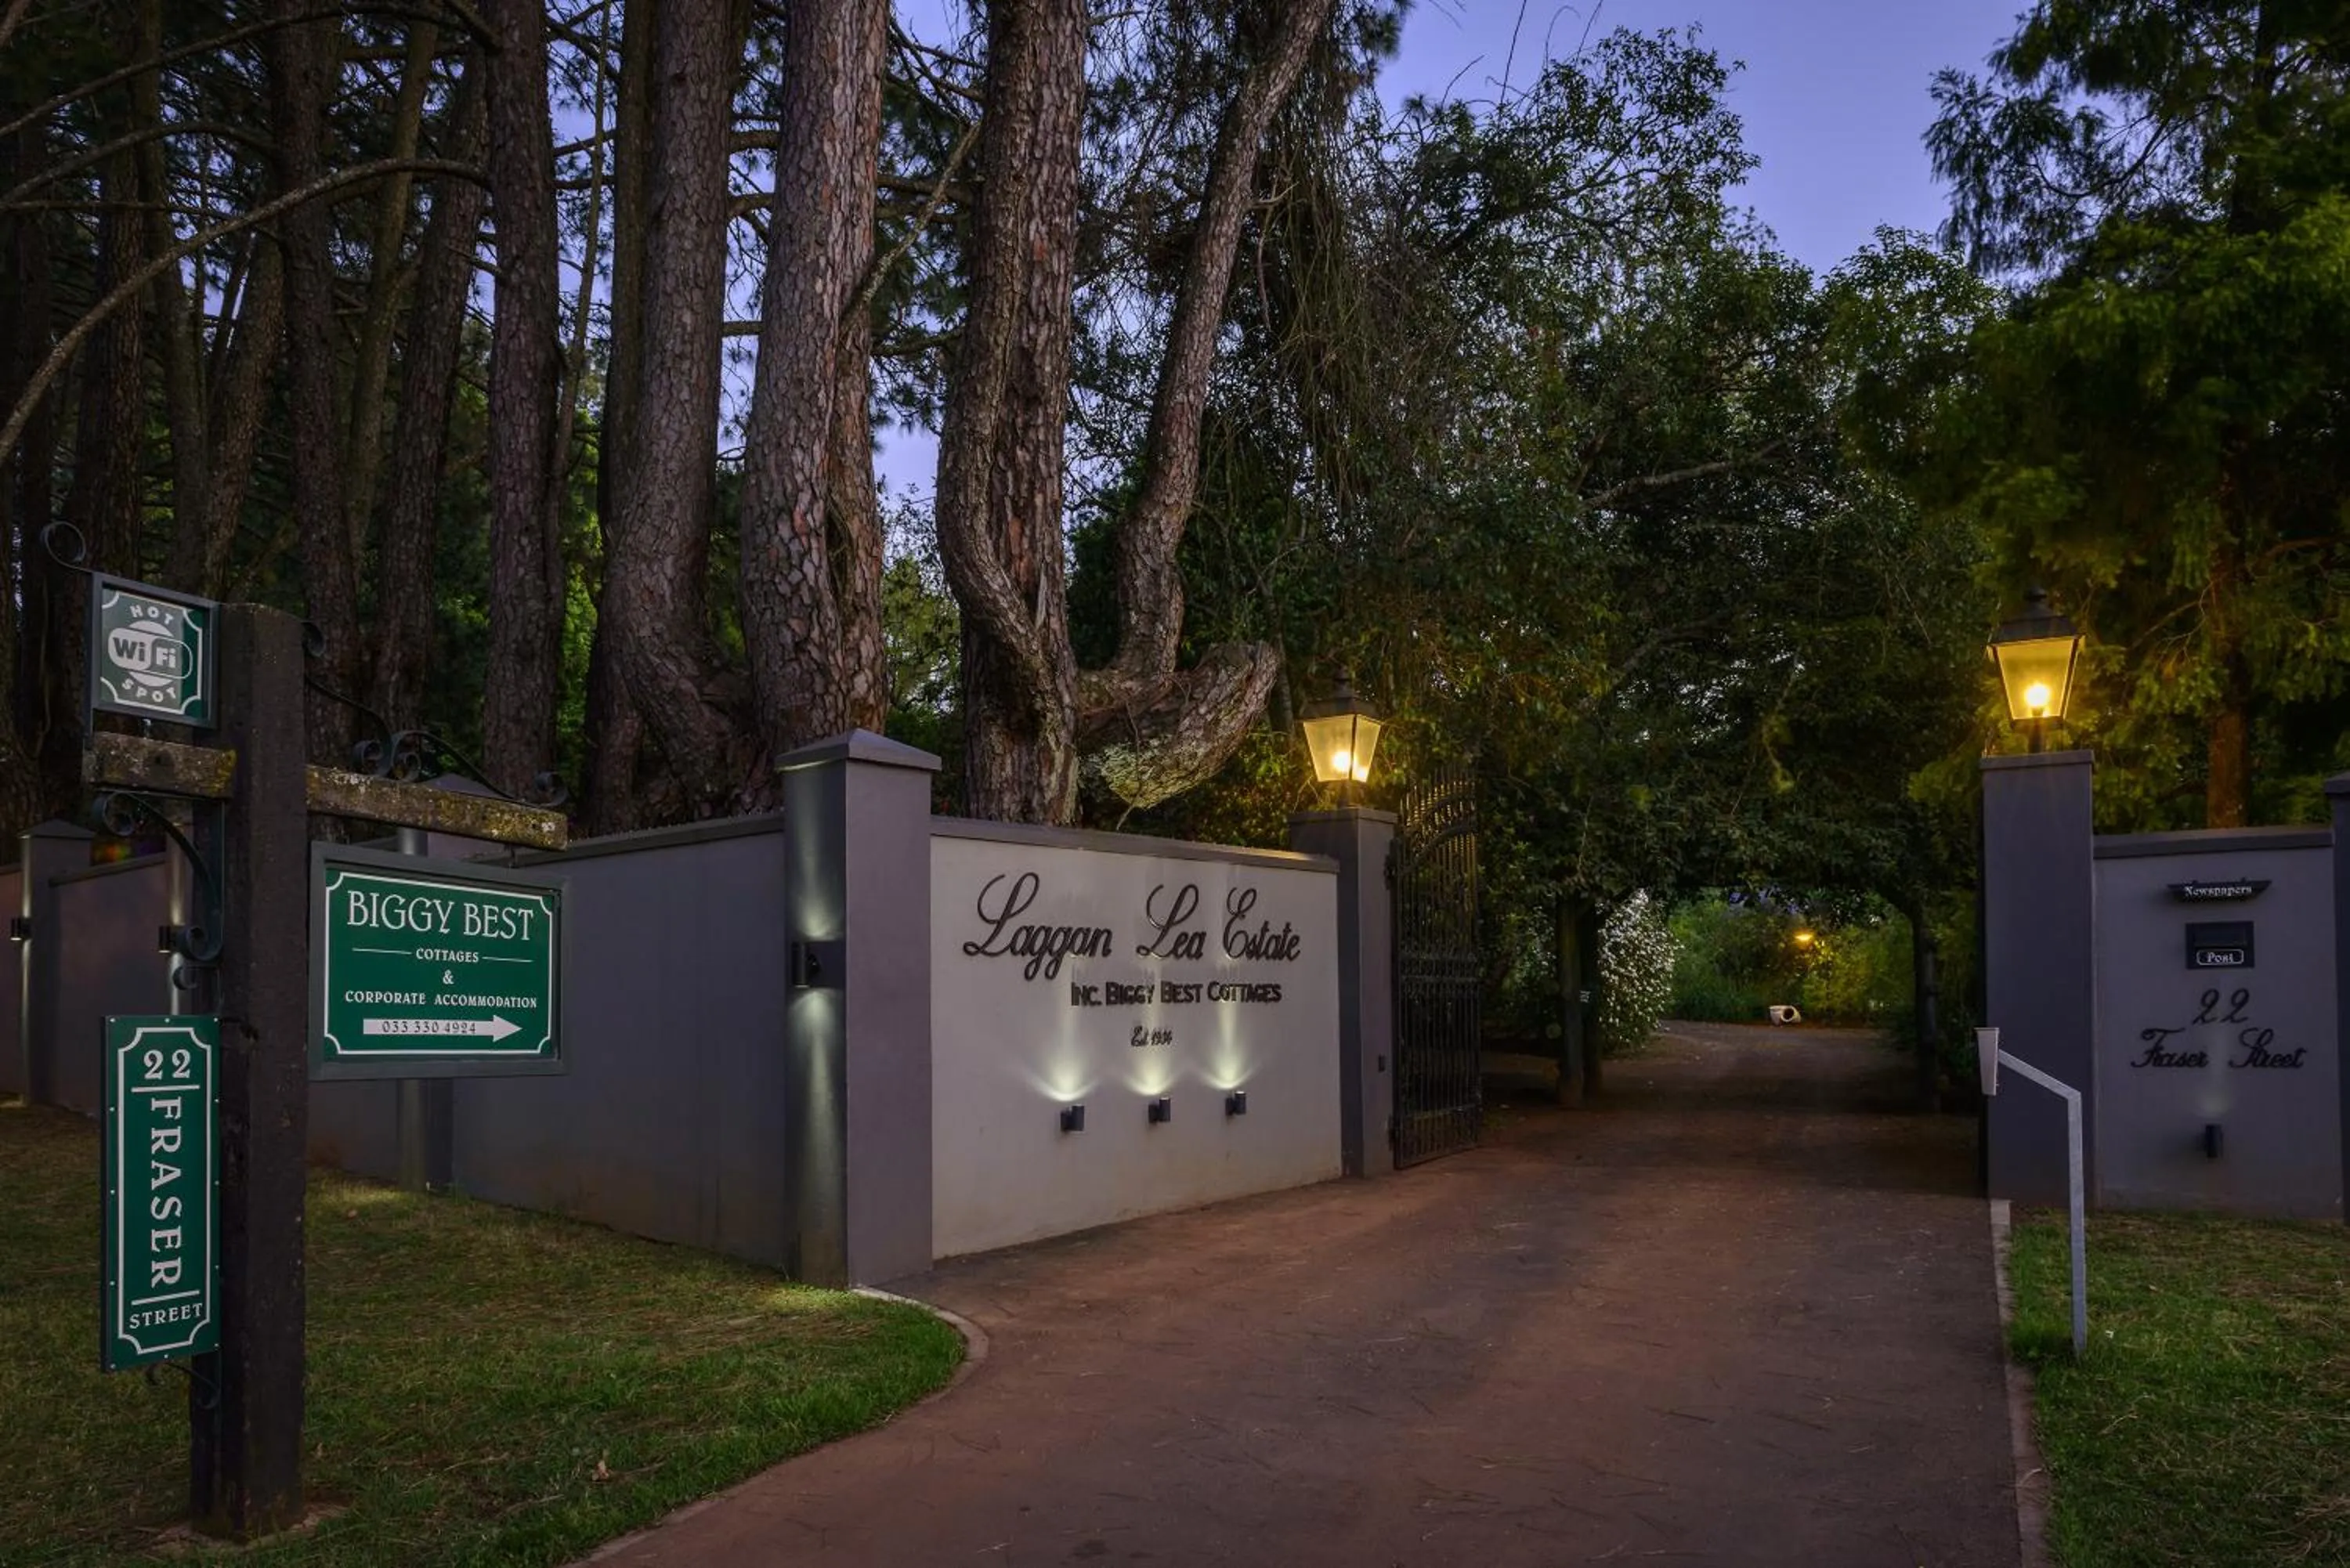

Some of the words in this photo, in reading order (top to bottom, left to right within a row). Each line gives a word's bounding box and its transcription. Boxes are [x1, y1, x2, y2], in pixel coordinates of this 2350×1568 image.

[130, 605, 174, 625] HOT
[122, 678, 176, 703] SPOT
[2185, 886, 2252, 897] Newspapers
[347, 890, 454, 934] BIGGY
[463, 903, 533, 941] BEST
[963, 872, 1113, 981] Laggan
[1136, 883, 1206, 960] Lea
[1222, 887, 1301, 963] Estate
[416, 948, 479, 963] COTTAGES
[2207, 952, 2233, 963] Post
[443, 970, 454, 985] &
[345, 991, 426, 1005] CORPORATE
[434, 994, 537, 1008] ACCOMMODATION
[1160, 981, 1203, 1003] BEST
[1207, 980, 1282, 1004] COTTAGES
[2193, 988, 2250, 1024] 22
[381, 1020, 409, 1033] 033
[414, 1021, 439, 1033] 330
[444, 1021, 476, 1034] 4924
[2131, 1028, 2209, 1068] Fraser
[2229, 1027, 2307, 1068] Street
[143, 1049, 191, 1079] 22
[150, 1097, 183, 1288] FRASER
[129, 1302, 203, 1329] STREET
